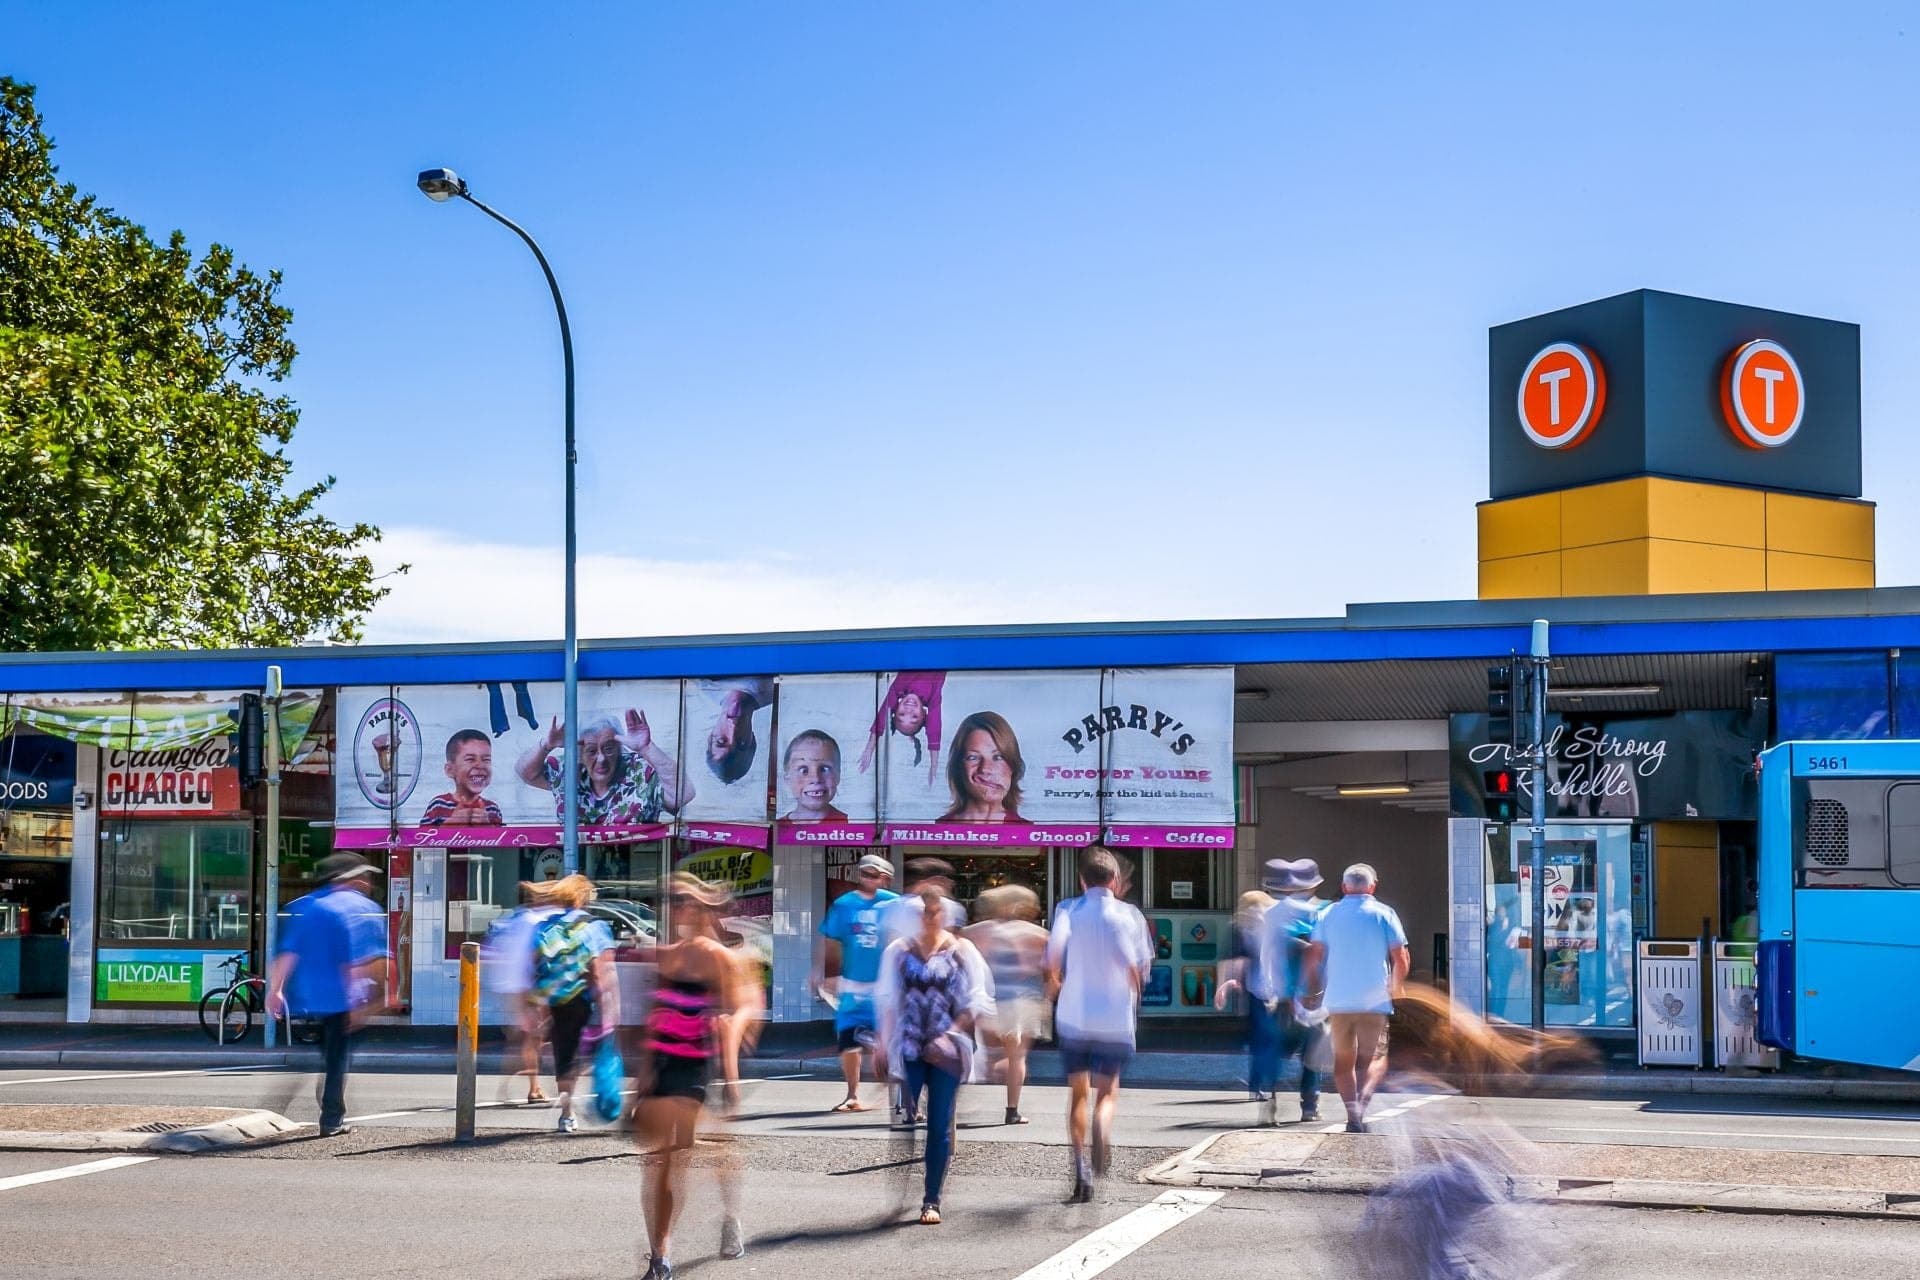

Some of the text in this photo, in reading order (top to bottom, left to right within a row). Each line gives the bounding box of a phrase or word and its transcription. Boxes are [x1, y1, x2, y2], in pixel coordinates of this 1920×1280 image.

[1539, 367, 1571, 425] T
[1754, 367, 1784, 424] T
[368, 711, 408, 728] PARRY'S
[1062, 704, 1195, 755] PARRY'S
[1564, 726, 1666, 776] Strong
[1808, 757, 1847, 770] 5461
[1045, 766, 1212, 782] Forever Young
[1516, 763, 1632, 797] Rchelle
[107, 771, 212, 805] CHARCO
[1044, 789, 1093, 799] Parry's,
[1117, 789, 1138, 798] the
[1140, 789, 1161, 798] kid
[414, 829, 508, 847] Traditional
[795, 829, 1226, 844] Candies Milkshakes Chocolaes Coffee
[107, 964, 192, 983] LILYDALE
